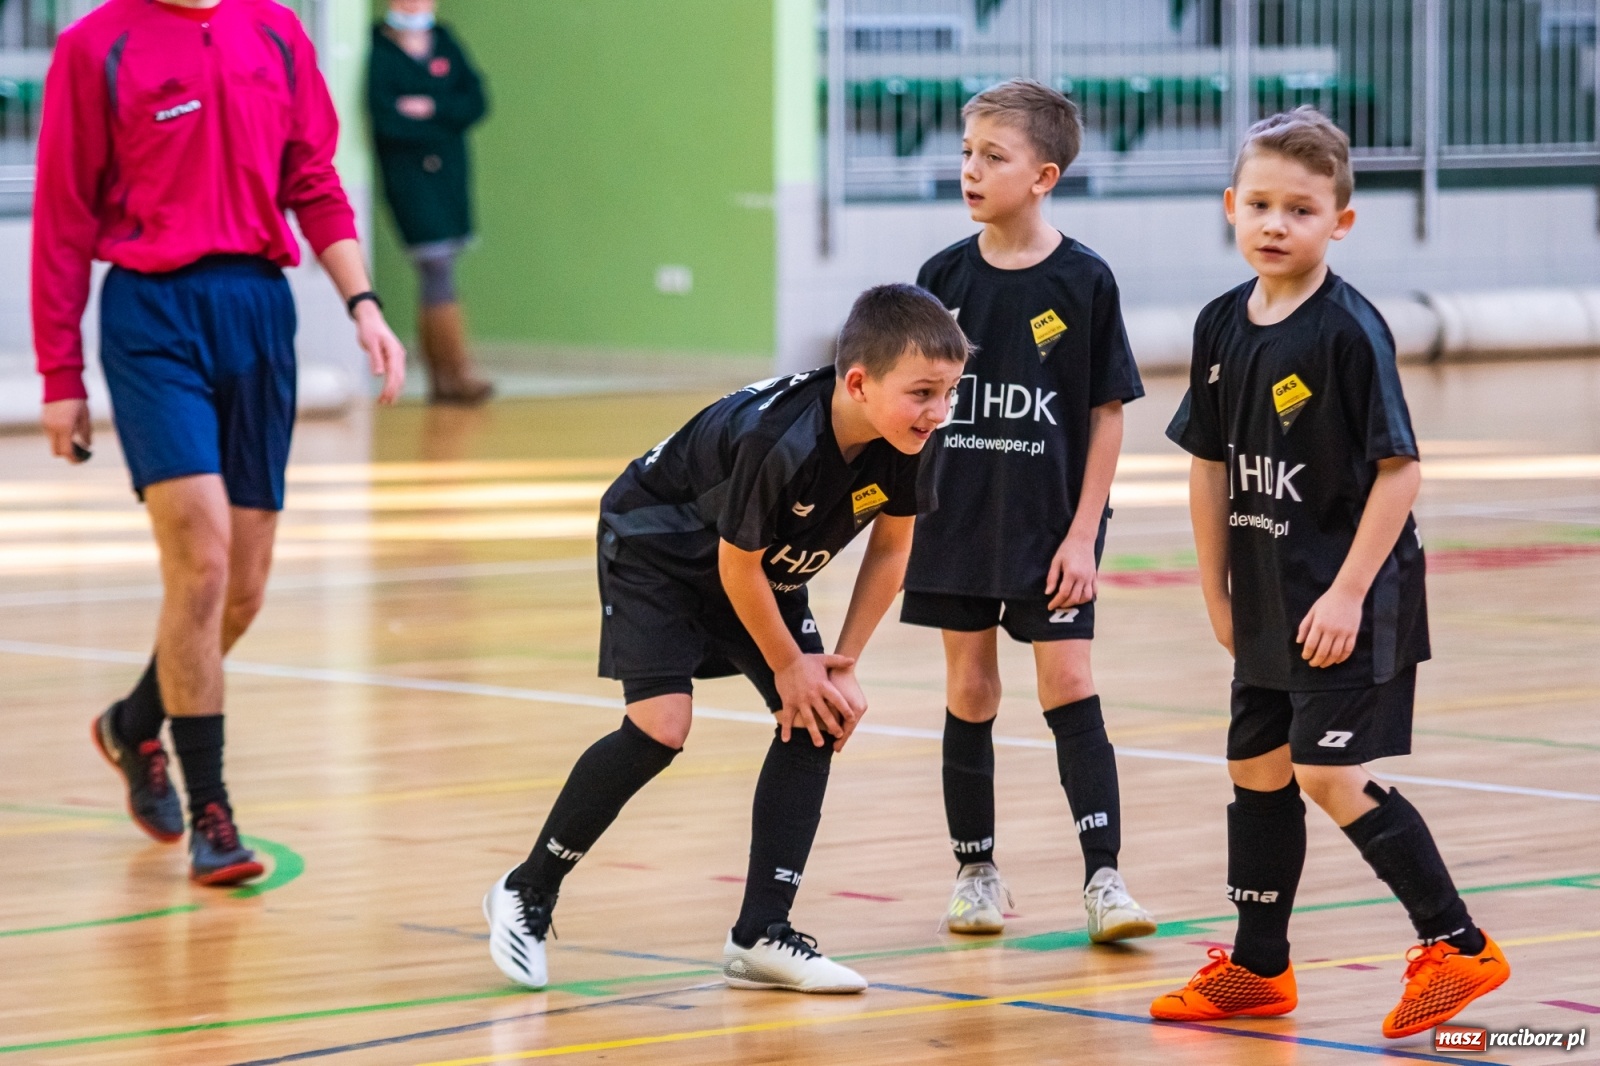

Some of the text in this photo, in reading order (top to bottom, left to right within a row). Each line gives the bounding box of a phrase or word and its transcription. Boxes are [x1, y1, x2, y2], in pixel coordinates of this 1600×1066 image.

[1034, 315, 1054, 329] GKS
[1275, 380, 1297, 396] GKS
[983, 383, 1058, 426] HDK
[1239, 454, 1306, 502] HDK
[855, 488, 877, 501] GKS
[770, 544, 832, 574] HD
[546, 837, 583, 861] zin
